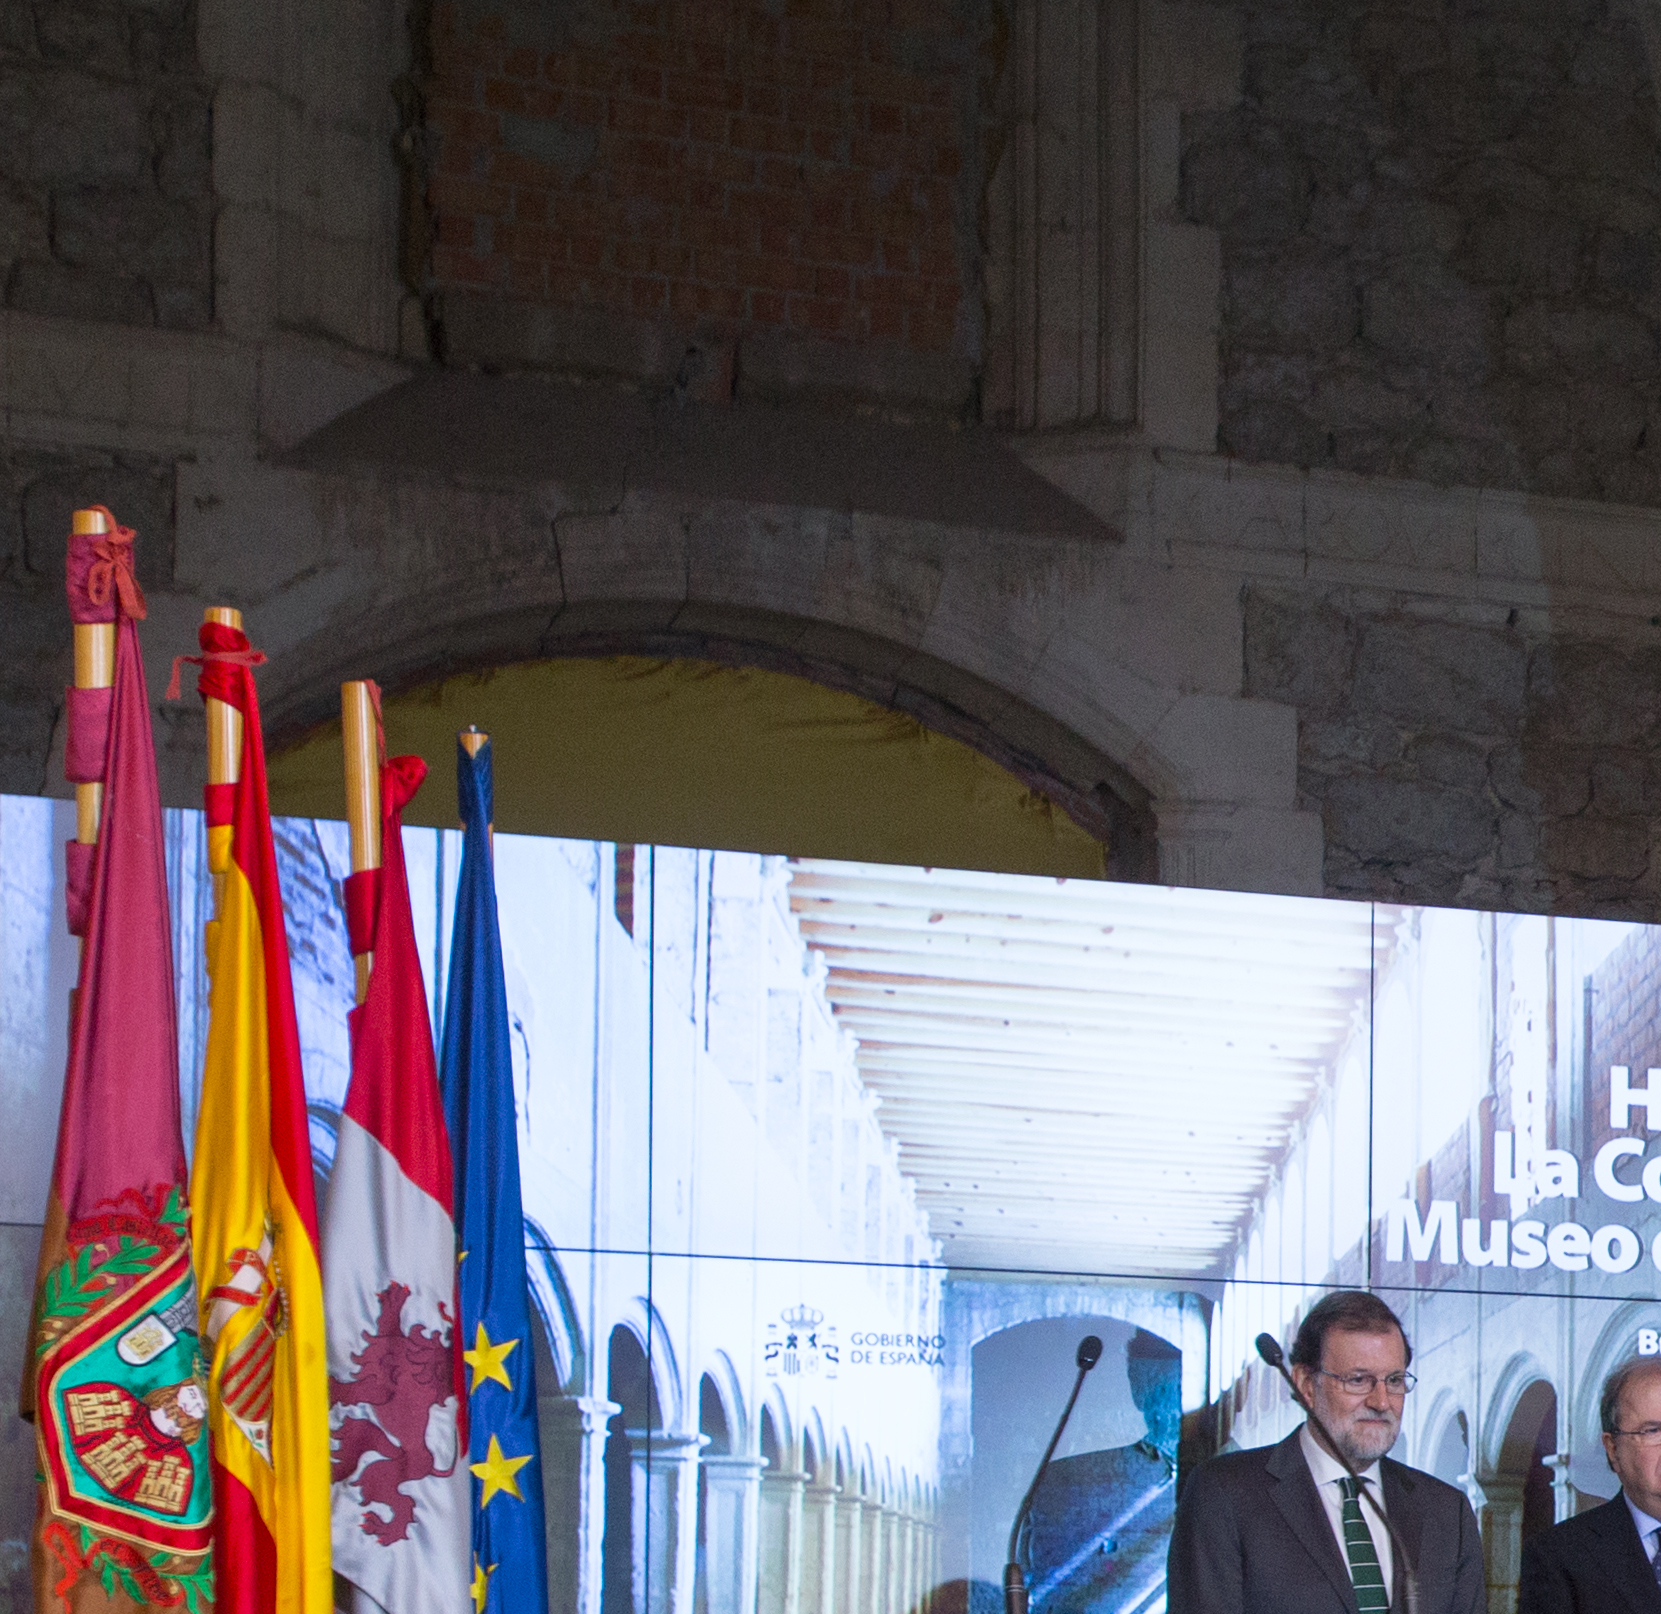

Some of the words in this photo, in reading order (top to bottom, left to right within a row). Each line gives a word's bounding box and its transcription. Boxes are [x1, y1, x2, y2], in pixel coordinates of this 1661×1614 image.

[1493, 1131, 1579, 1199] La
[1386, 1199, 1640, 1274] Museo
[850, 1332, 946, 1349] GOBIERNO
[850, 1350, 872, 1364] DE
[880, 1349, 946, 1366] ESPAÑA
